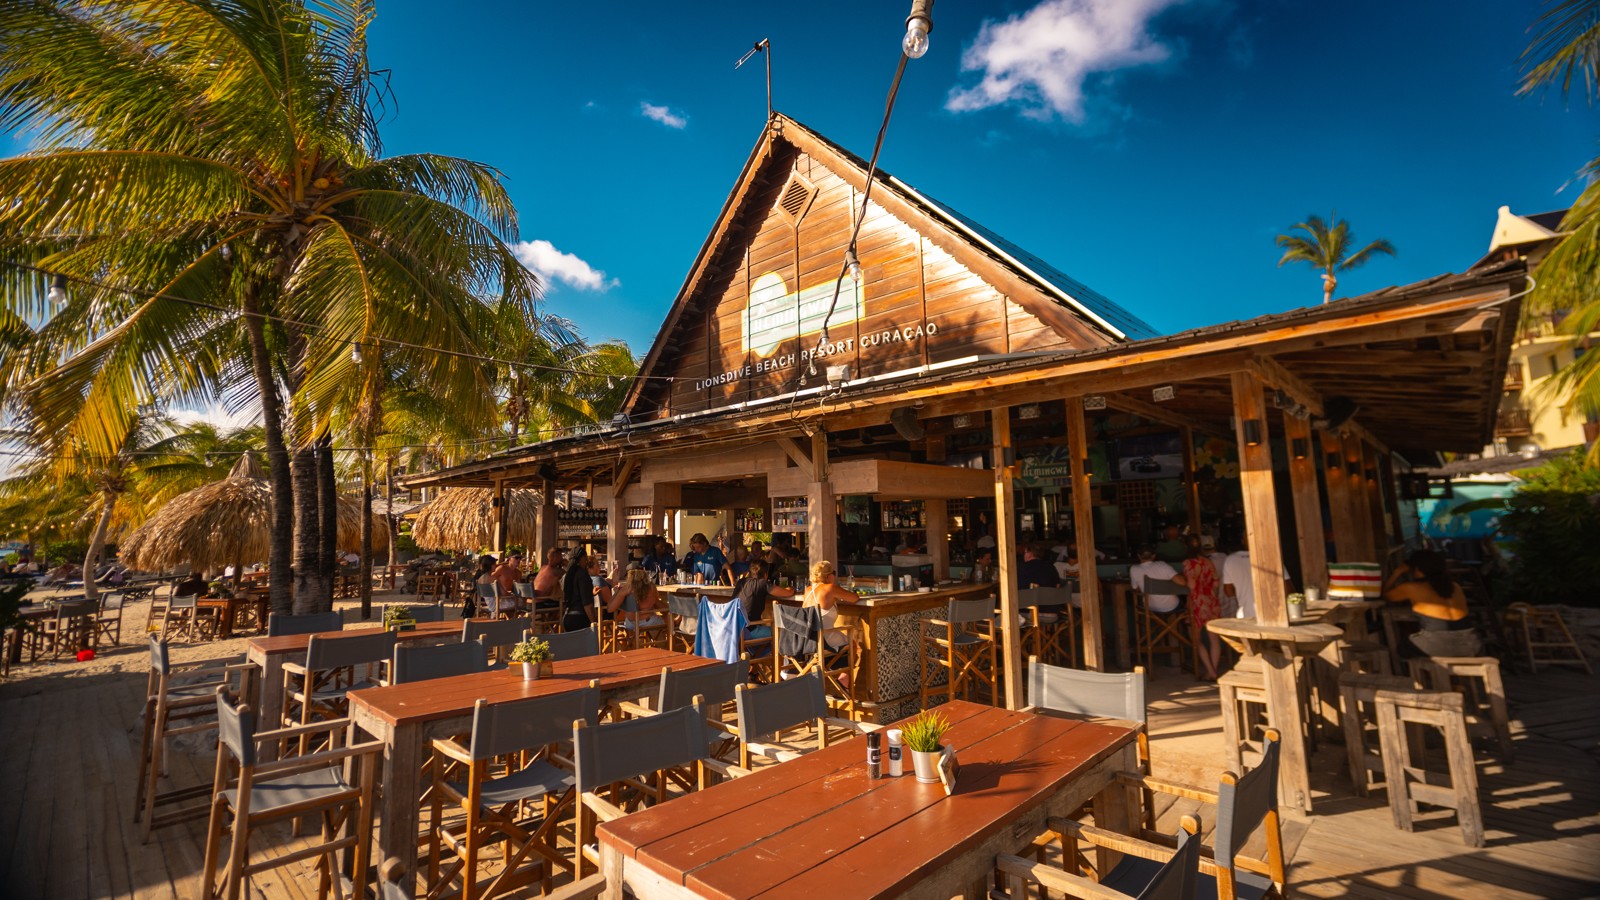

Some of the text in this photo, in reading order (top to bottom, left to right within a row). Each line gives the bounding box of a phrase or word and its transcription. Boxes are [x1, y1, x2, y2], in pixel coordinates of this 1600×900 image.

[696, 323, 937, 391] LIONSDIVE BEACH RESORT CURAÇAO
